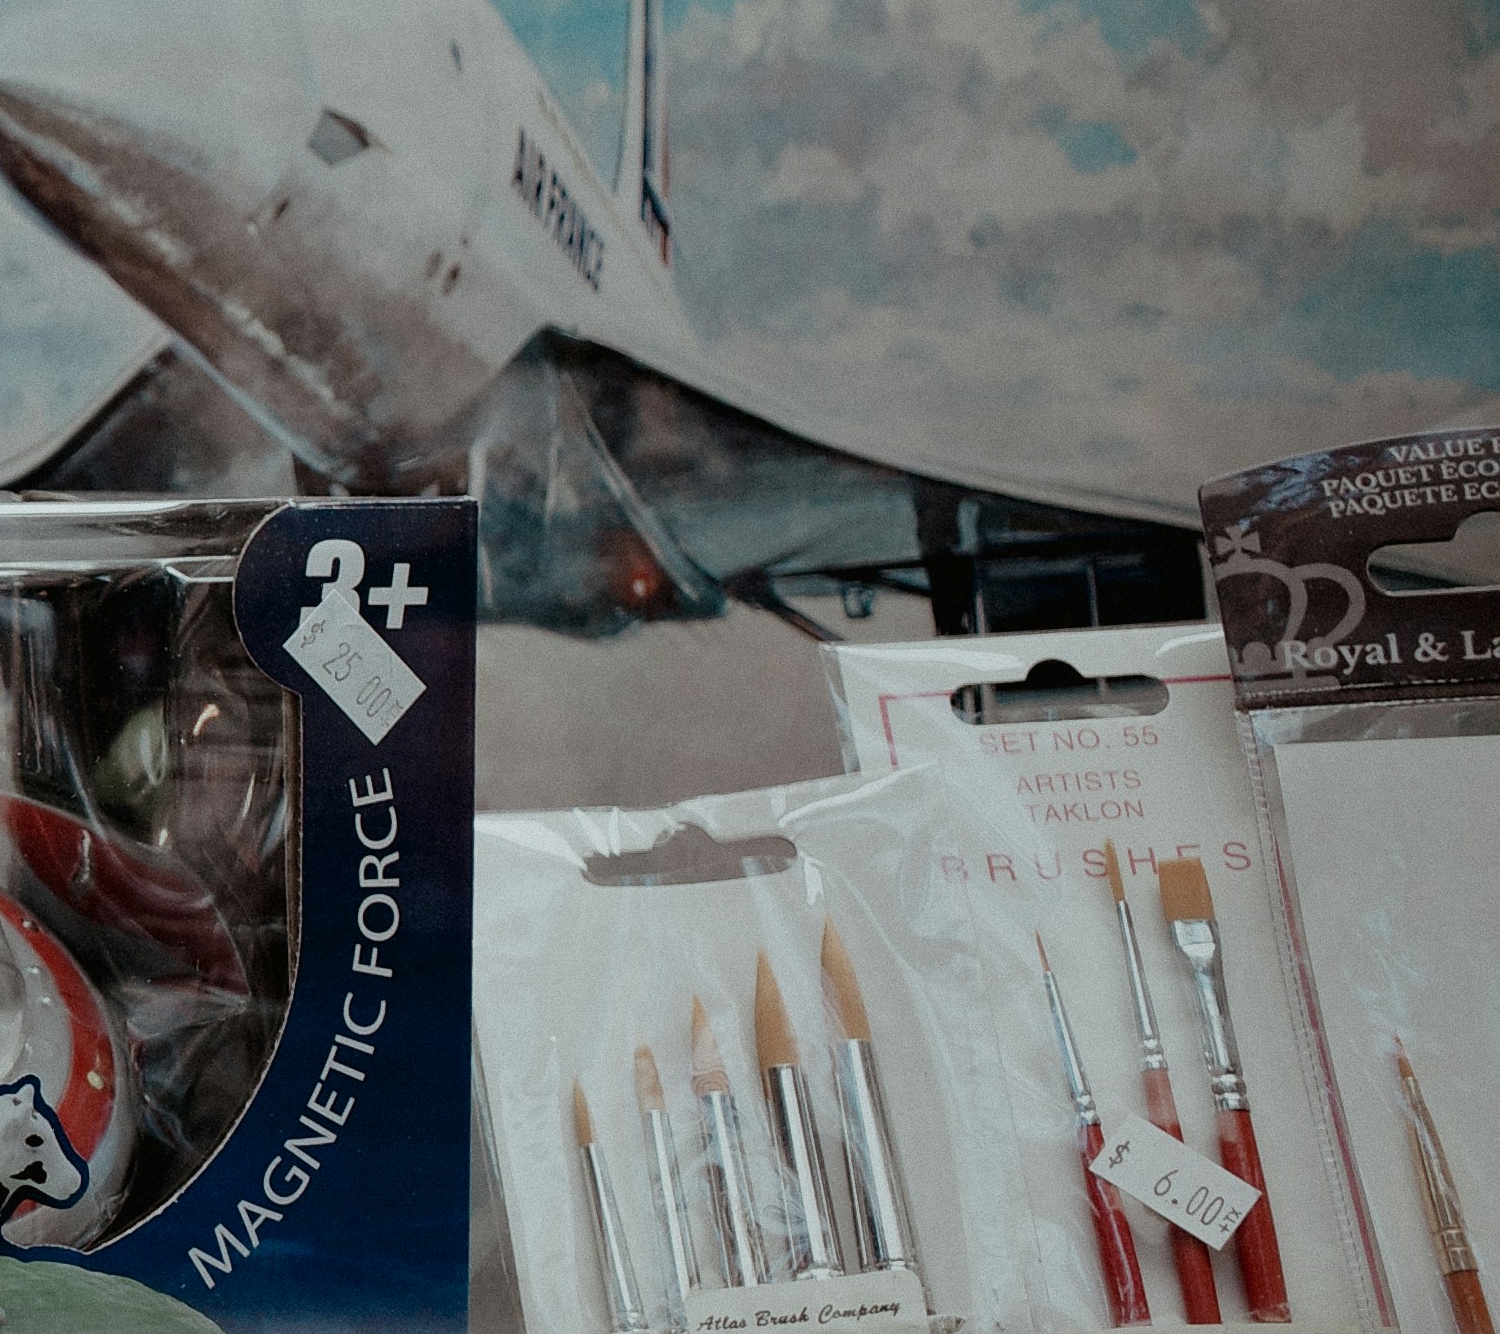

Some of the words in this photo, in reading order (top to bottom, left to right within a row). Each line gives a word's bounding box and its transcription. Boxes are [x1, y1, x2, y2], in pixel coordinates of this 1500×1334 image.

[1387, 437, 1485, 464] VALUE
[1320, 464, 1435, 497] PAQUET
[1327, 484, 1458, 517] PAQUETE
[301, 537, 430, 633] 3+
[1282, 632, 1403, 675] Royal
[1414, 632, 1450, 663] &
[979, 730, 1038, 755] SET
[1054, 727, 1112, 752] NO.
[1123, 725, 1159, 747] 55
[1017, 768, 1143, 796] ARTISTS
[1026, 798, 1146, 824] TAKLON
[187, 991, 389, 1291] MAGNETIC
[348, 766, 402, 981] FORCE
[1106, 1139, 1133, 1171] $
[697, 1315, 748, 1332] Atlas
[754, 1306, 810, 1328] Brush
[817, 1302, 901, 1325] Company
